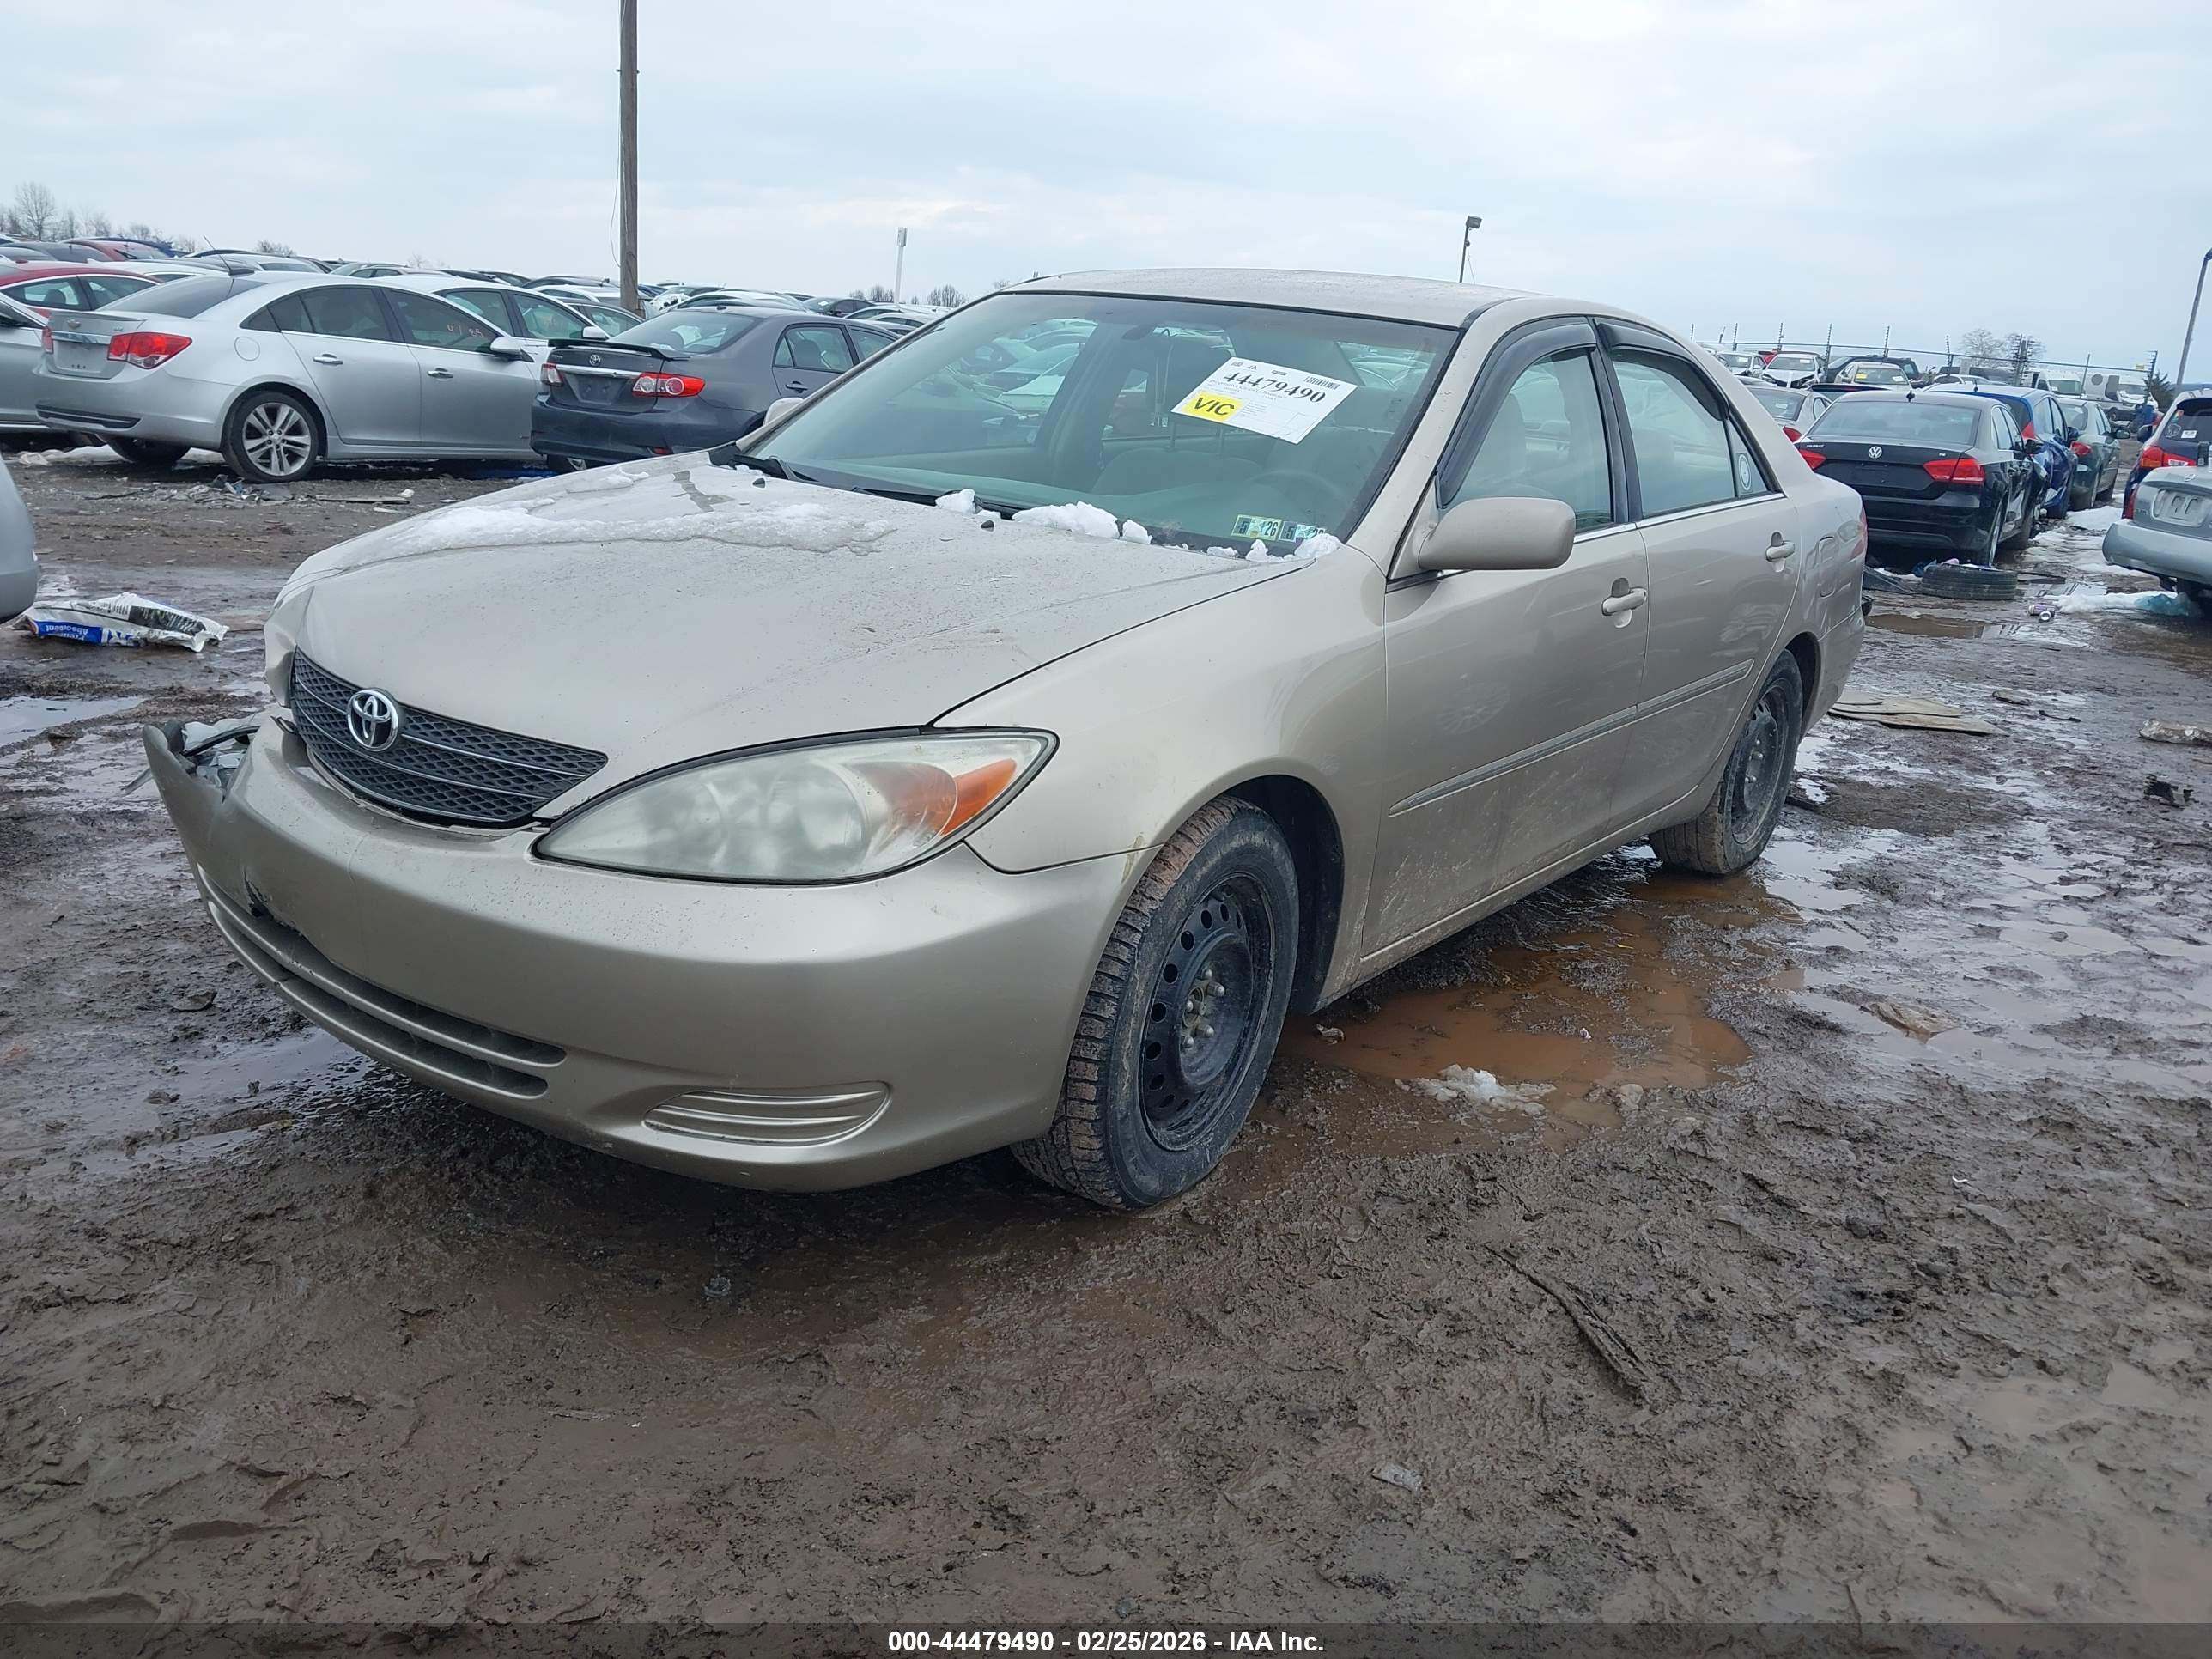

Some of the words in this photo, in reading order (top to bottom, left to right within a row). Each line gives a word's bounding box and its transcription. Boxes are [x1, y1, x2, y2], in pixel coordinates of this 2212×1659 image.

[1224, 372, 1326, 403] 44479490
[1194, 397, 1235, 416] VIC
[1264, 520, 1279, 537] 26
